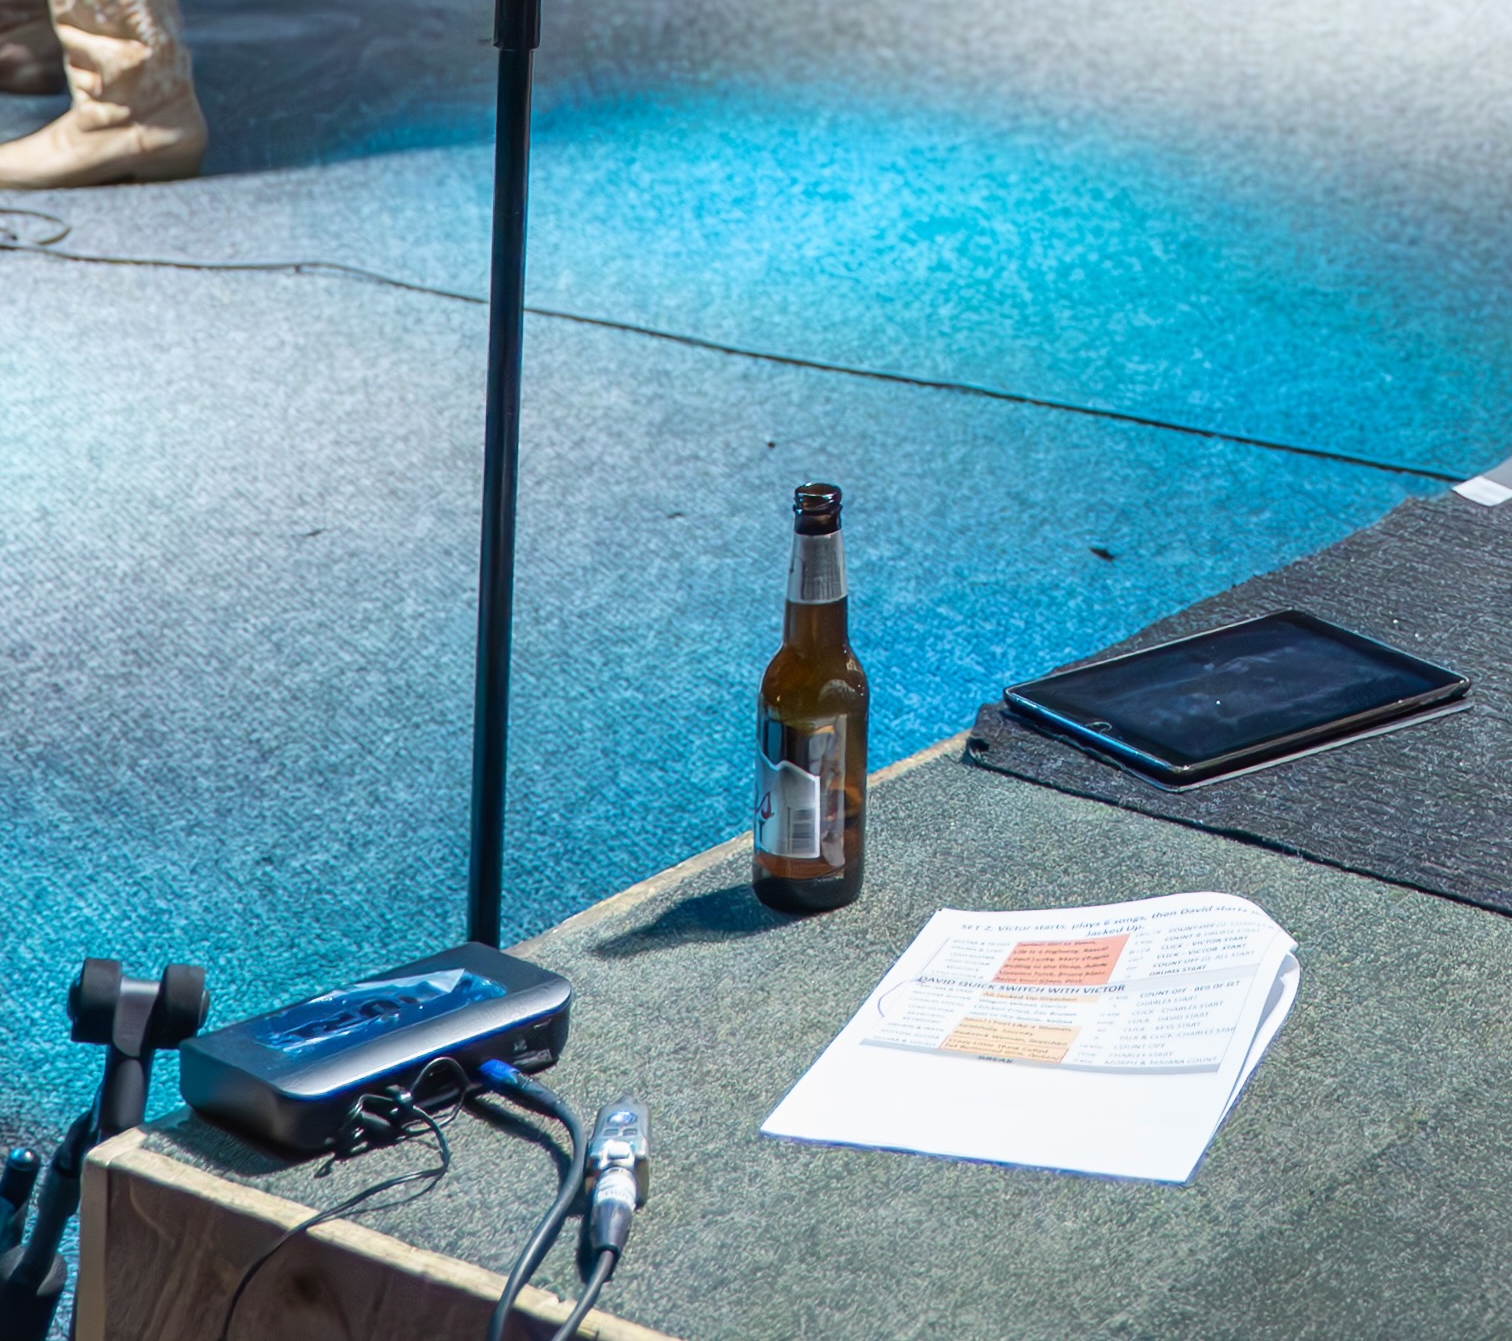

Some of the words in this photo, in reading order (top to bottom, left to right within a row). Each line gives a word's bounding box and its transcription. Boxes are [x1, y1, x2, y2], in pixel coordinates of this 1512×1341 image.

[1072, 921, 1101, 930] plays
[1152, 910, 1177, 919] then
[1181, 906, 1213, 915] David
[1086, 927, 1123, 937] Jacked
[1192, 937, 1221, 946] VICTOR
[918, 976, 956, 985] DAVID
[958, 979, 995, 990] QUICK
[999, 984, 1044, 993] SWITCH
[1048, 986, 1080, 994] WITH
[1083, 984, 1125, 994] VICTOR
